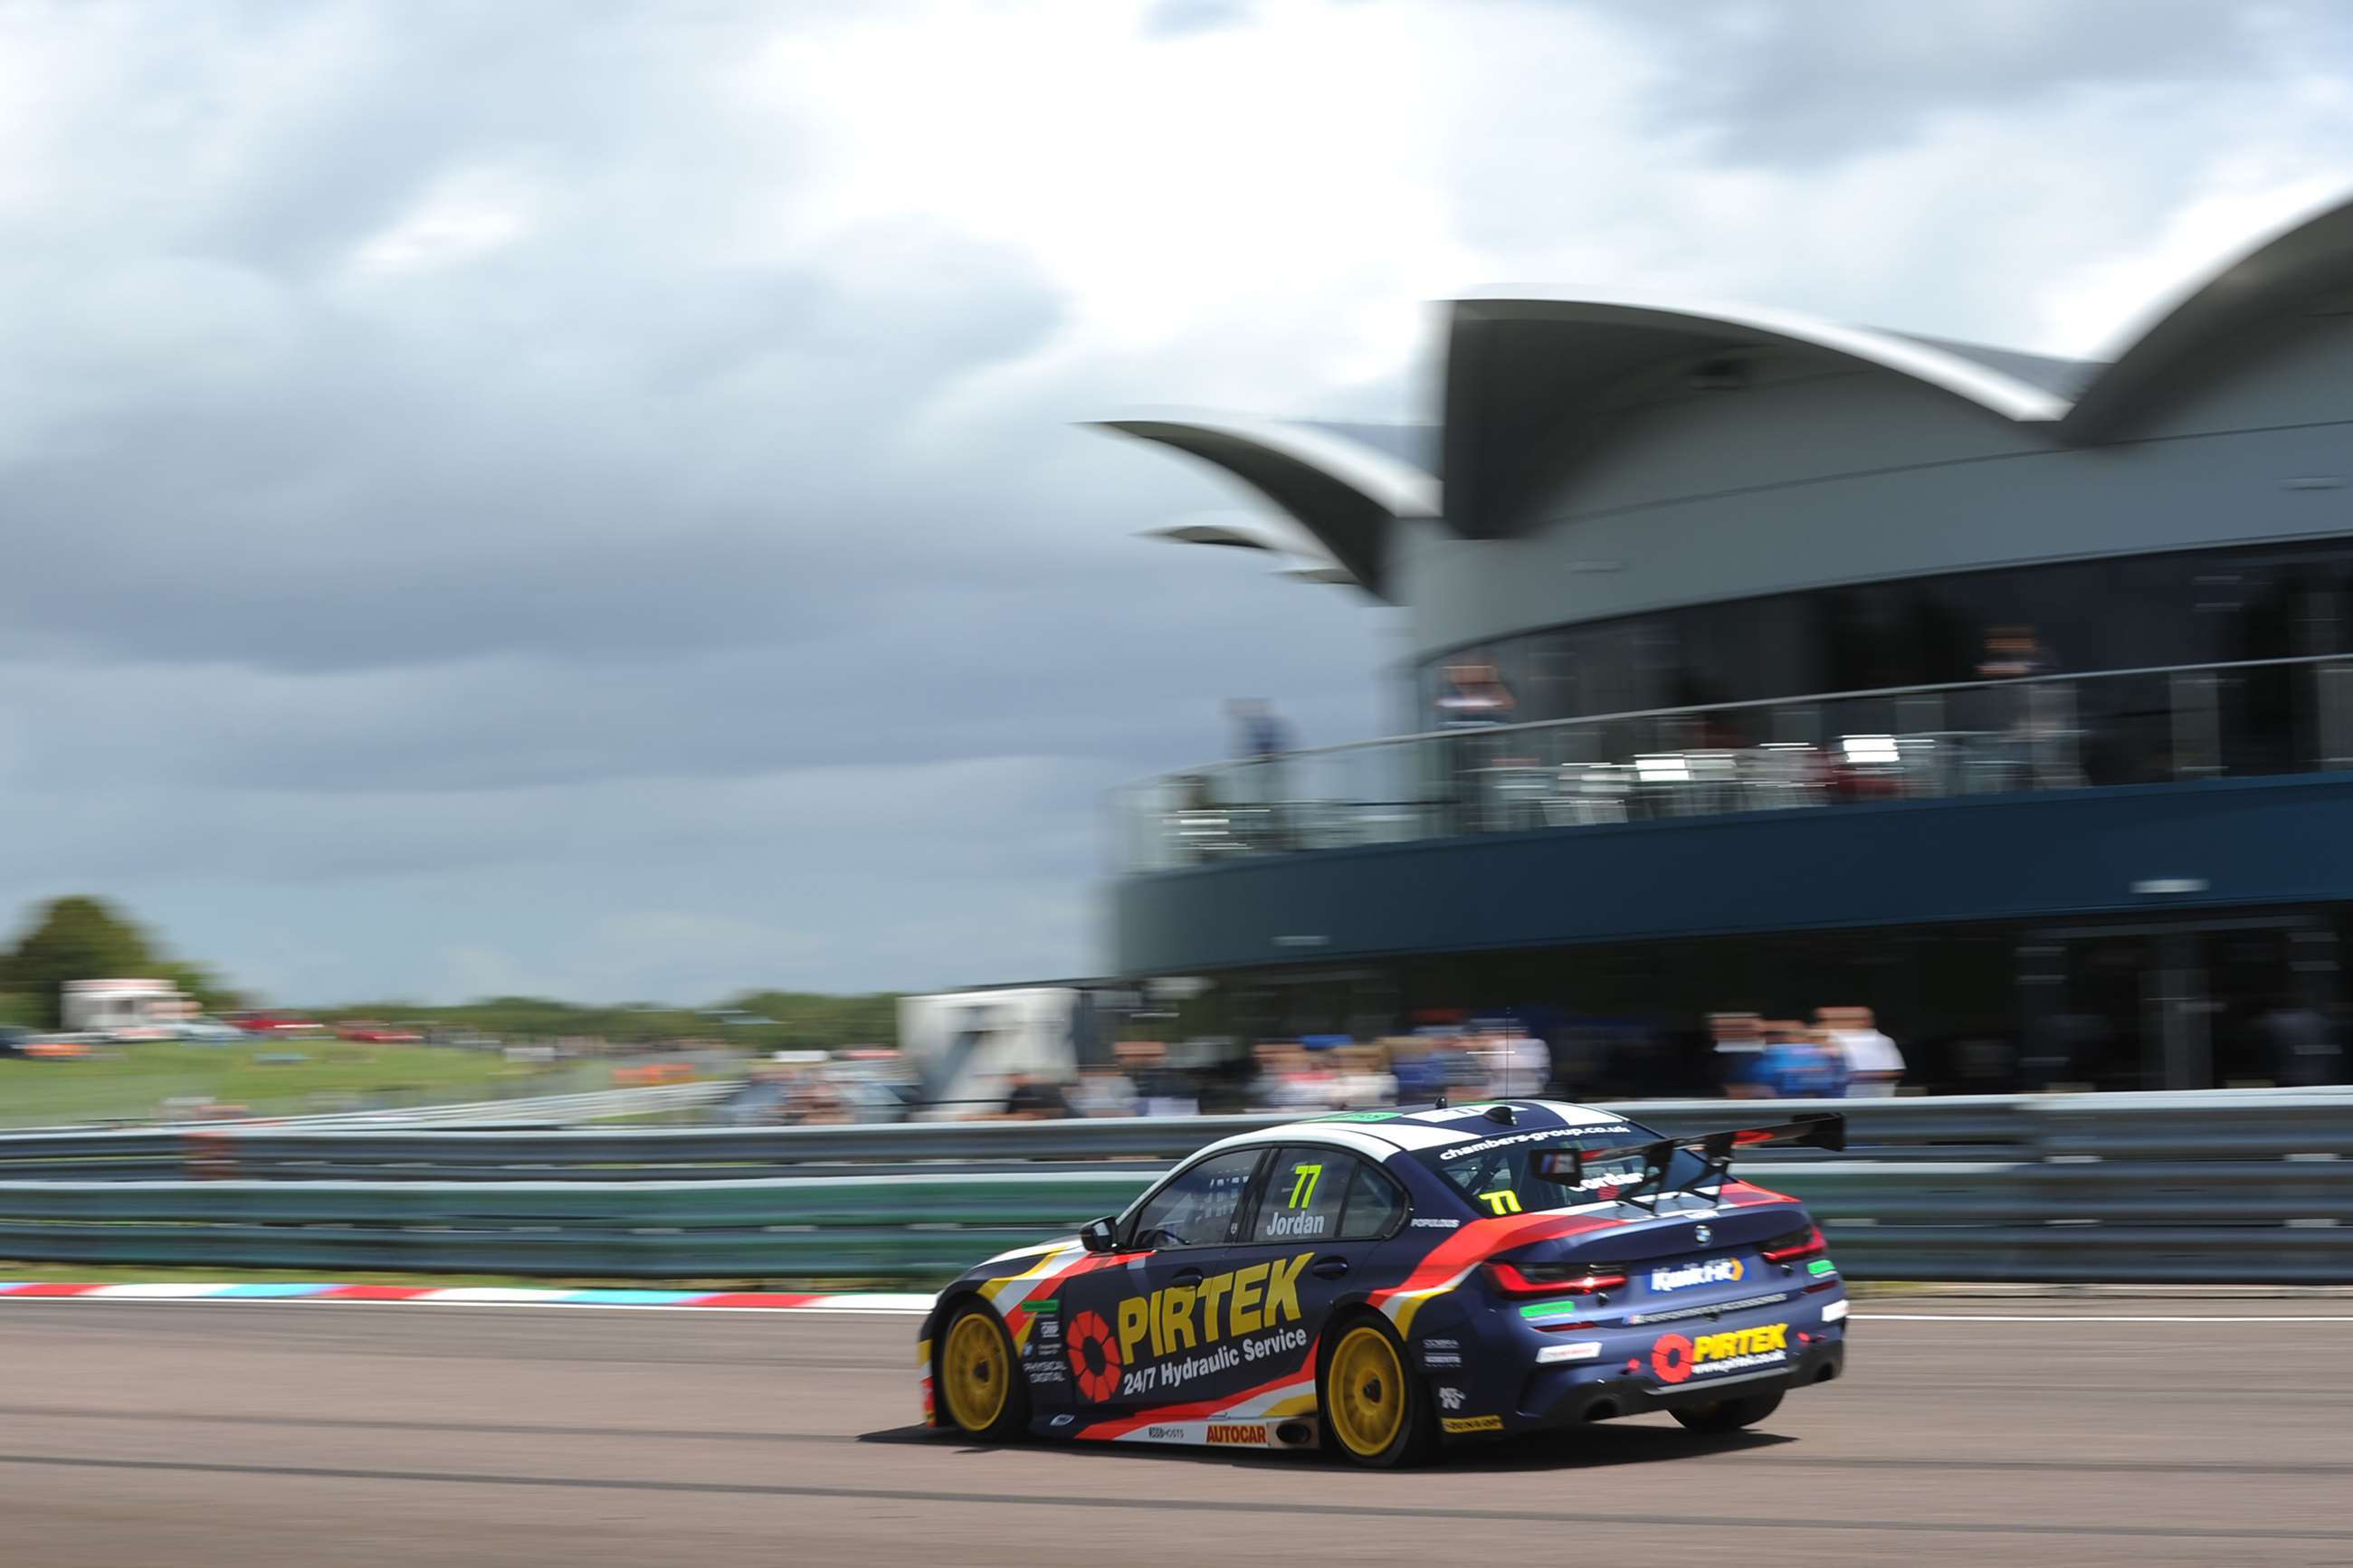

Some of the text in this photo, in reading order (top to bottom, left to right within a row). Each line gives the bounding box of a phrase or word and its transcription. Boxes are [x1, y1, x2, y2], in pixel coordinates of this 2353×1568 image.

[1440, 1125, 1631, 1160] chambers-group.co.uk
[1289, 1164, 1322, 1209] 77
[1478, 1189, 1522, 1216] 77
[1266, 1211, 1325, 1236] Jordan
[1118, 1251, 1315, 1365] PIRTEK
[1694, 1323, 1789, 1363] PIRTEK
[1123, 1328, 1308, 1396] 24/7 Hydraulic Service
[1206, 1425, 1267, 1443] AUTOCAR
